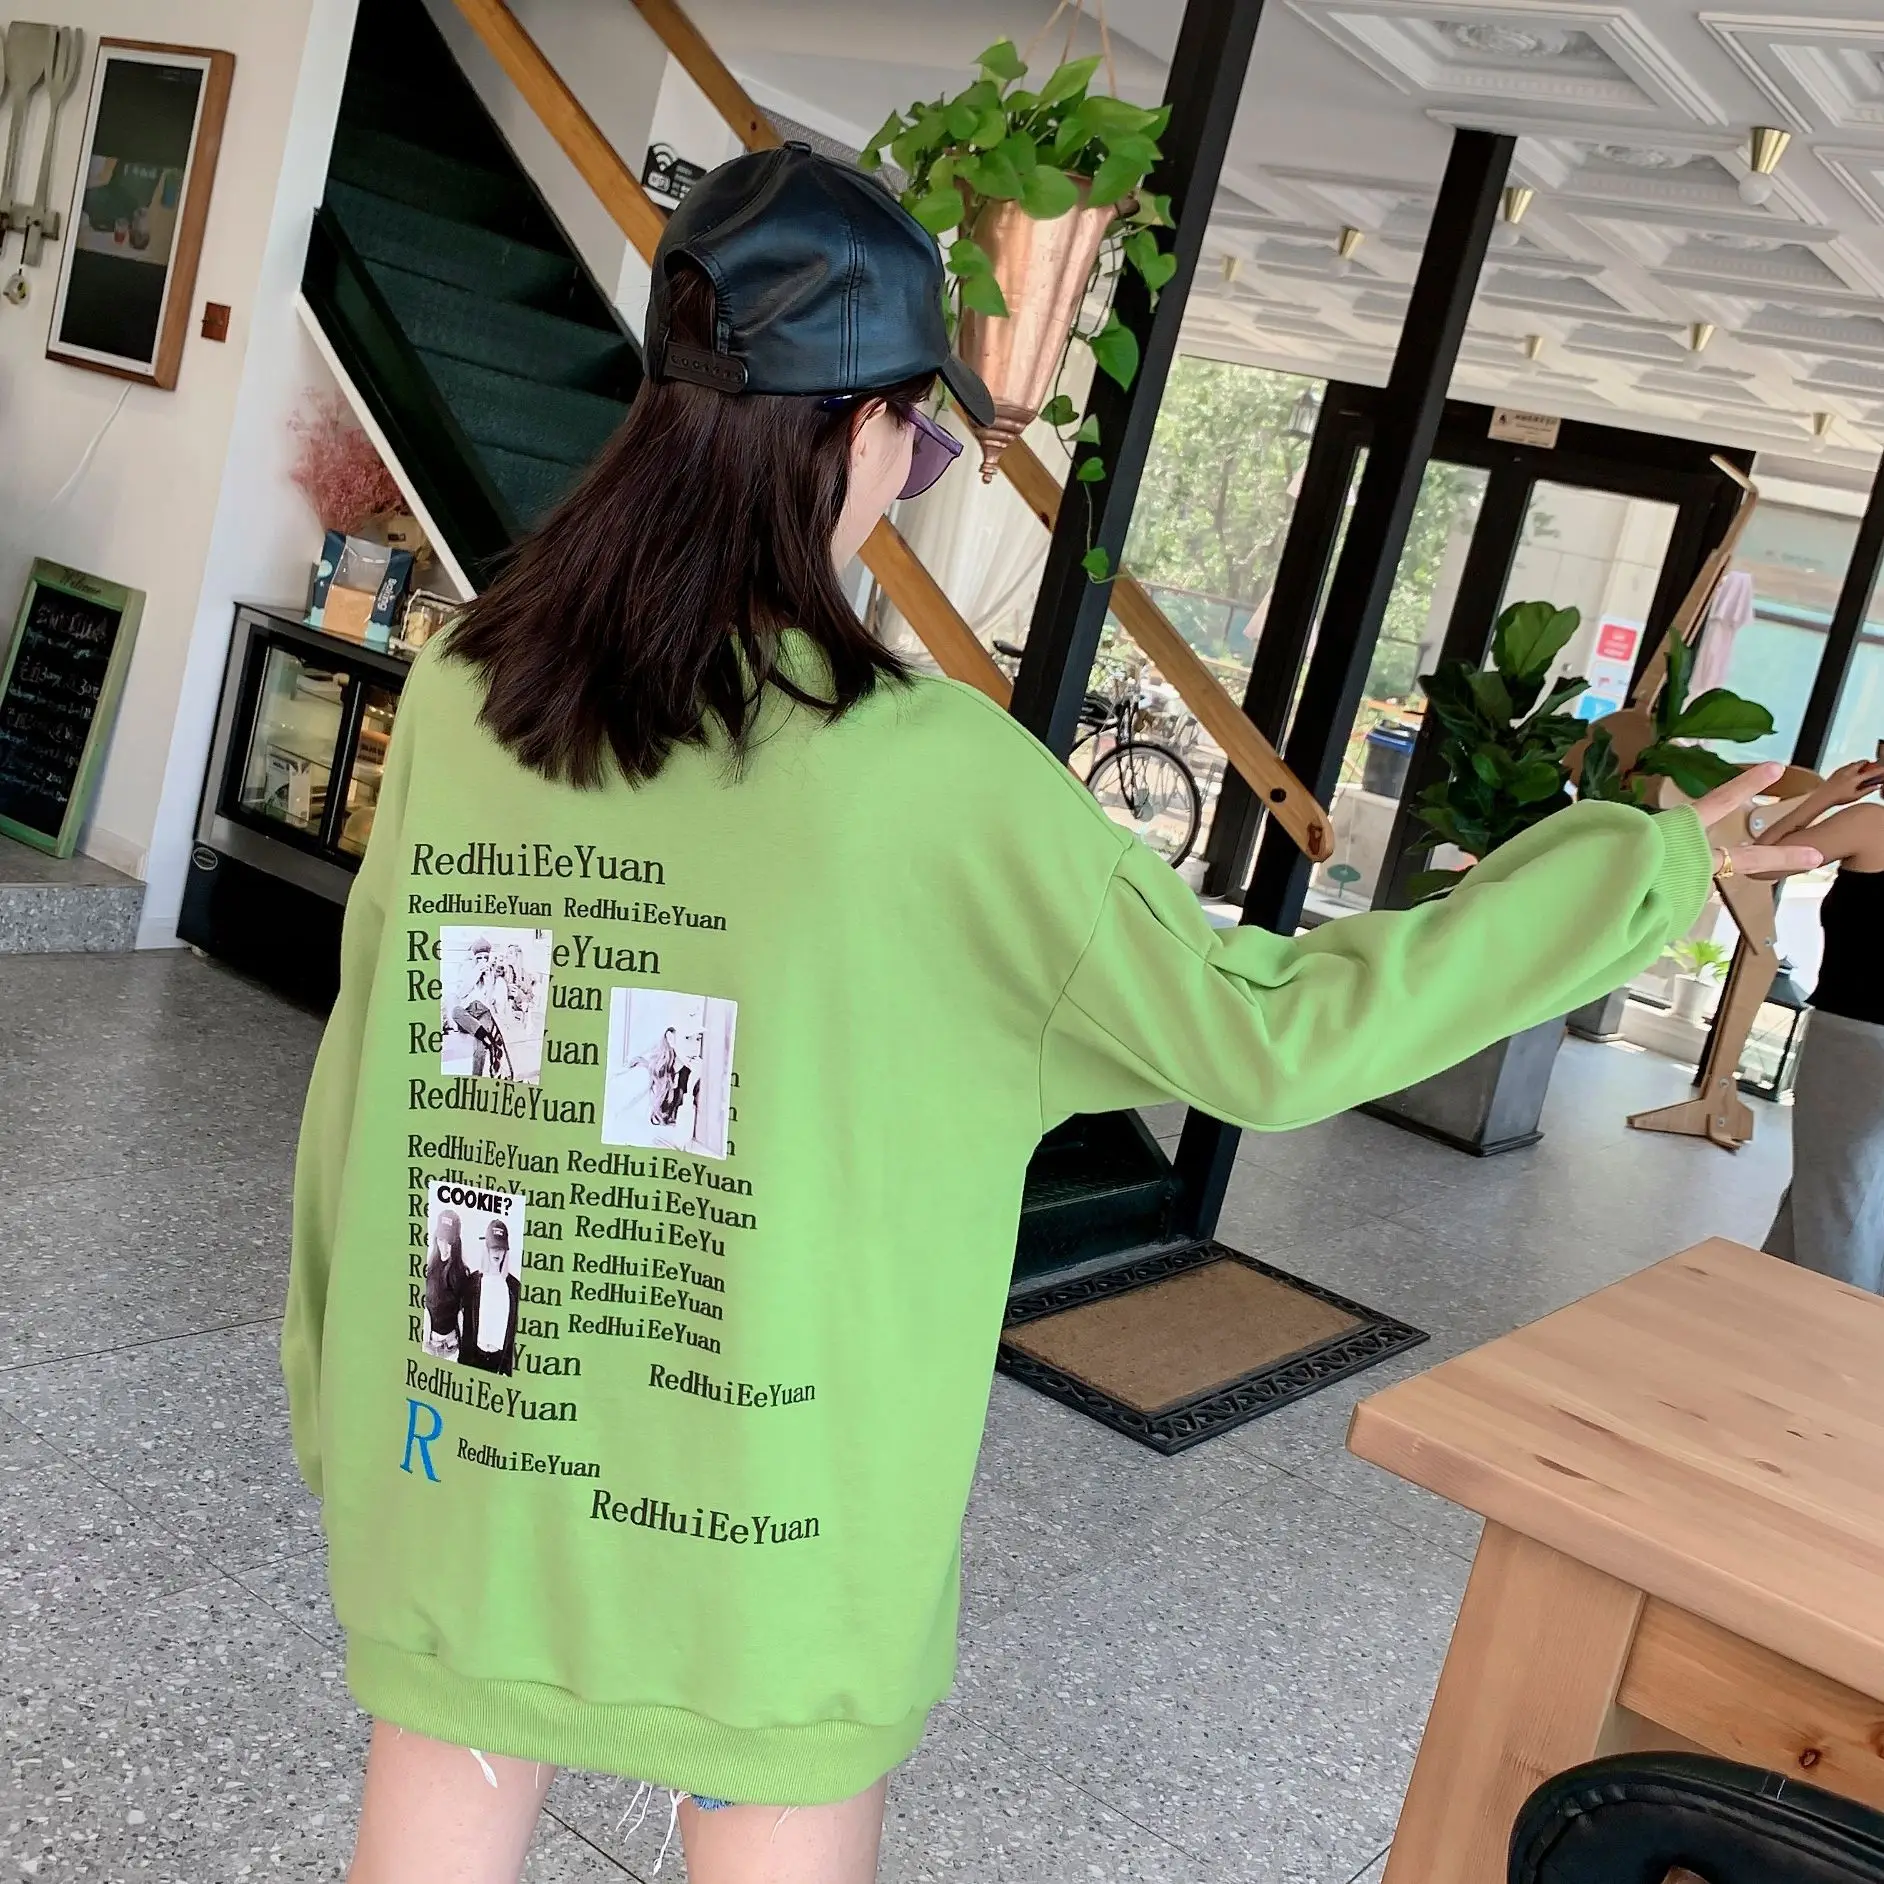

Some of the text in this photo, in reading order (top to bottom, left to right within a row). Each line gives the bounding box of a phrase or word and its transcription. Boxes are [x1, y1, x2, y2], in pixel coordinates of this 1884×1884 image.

[410, 842, 666, 885] RedHuiEeYuan
[407, 894, 727, 931] RedHuiEeYuan RedHuiEeYuan
[408, 1078, 596, 1124] RedHuiEeYuan
[407, 1134, 753, 1196] RedHuiEeYuan RedHuiEeYuan
[436, 1185, 514, 1216] COOKIE?
[569, 1183, 758, 1230] RedHuiEeYuan
[574, 1215, 726, 1257] RedHuiEeYu
[572, 1252, 726, 1293] RedHuiEeYuan
[570, 1280, 724, 1321] RedHuiEeYuan
[567, 1313, 721, 1355] RedHuiEeYuan
[406, 1358, 578, 1422] RedHuiEeYuan
[649, 1363, 816, 1408] RedHuiEeYuan
[400, 1396, 444, 1483] R
[457, 1437, 601, 1479] RedHuiEeYuan
[589, 1488, 821, 1546] RedHuiEeYuan
